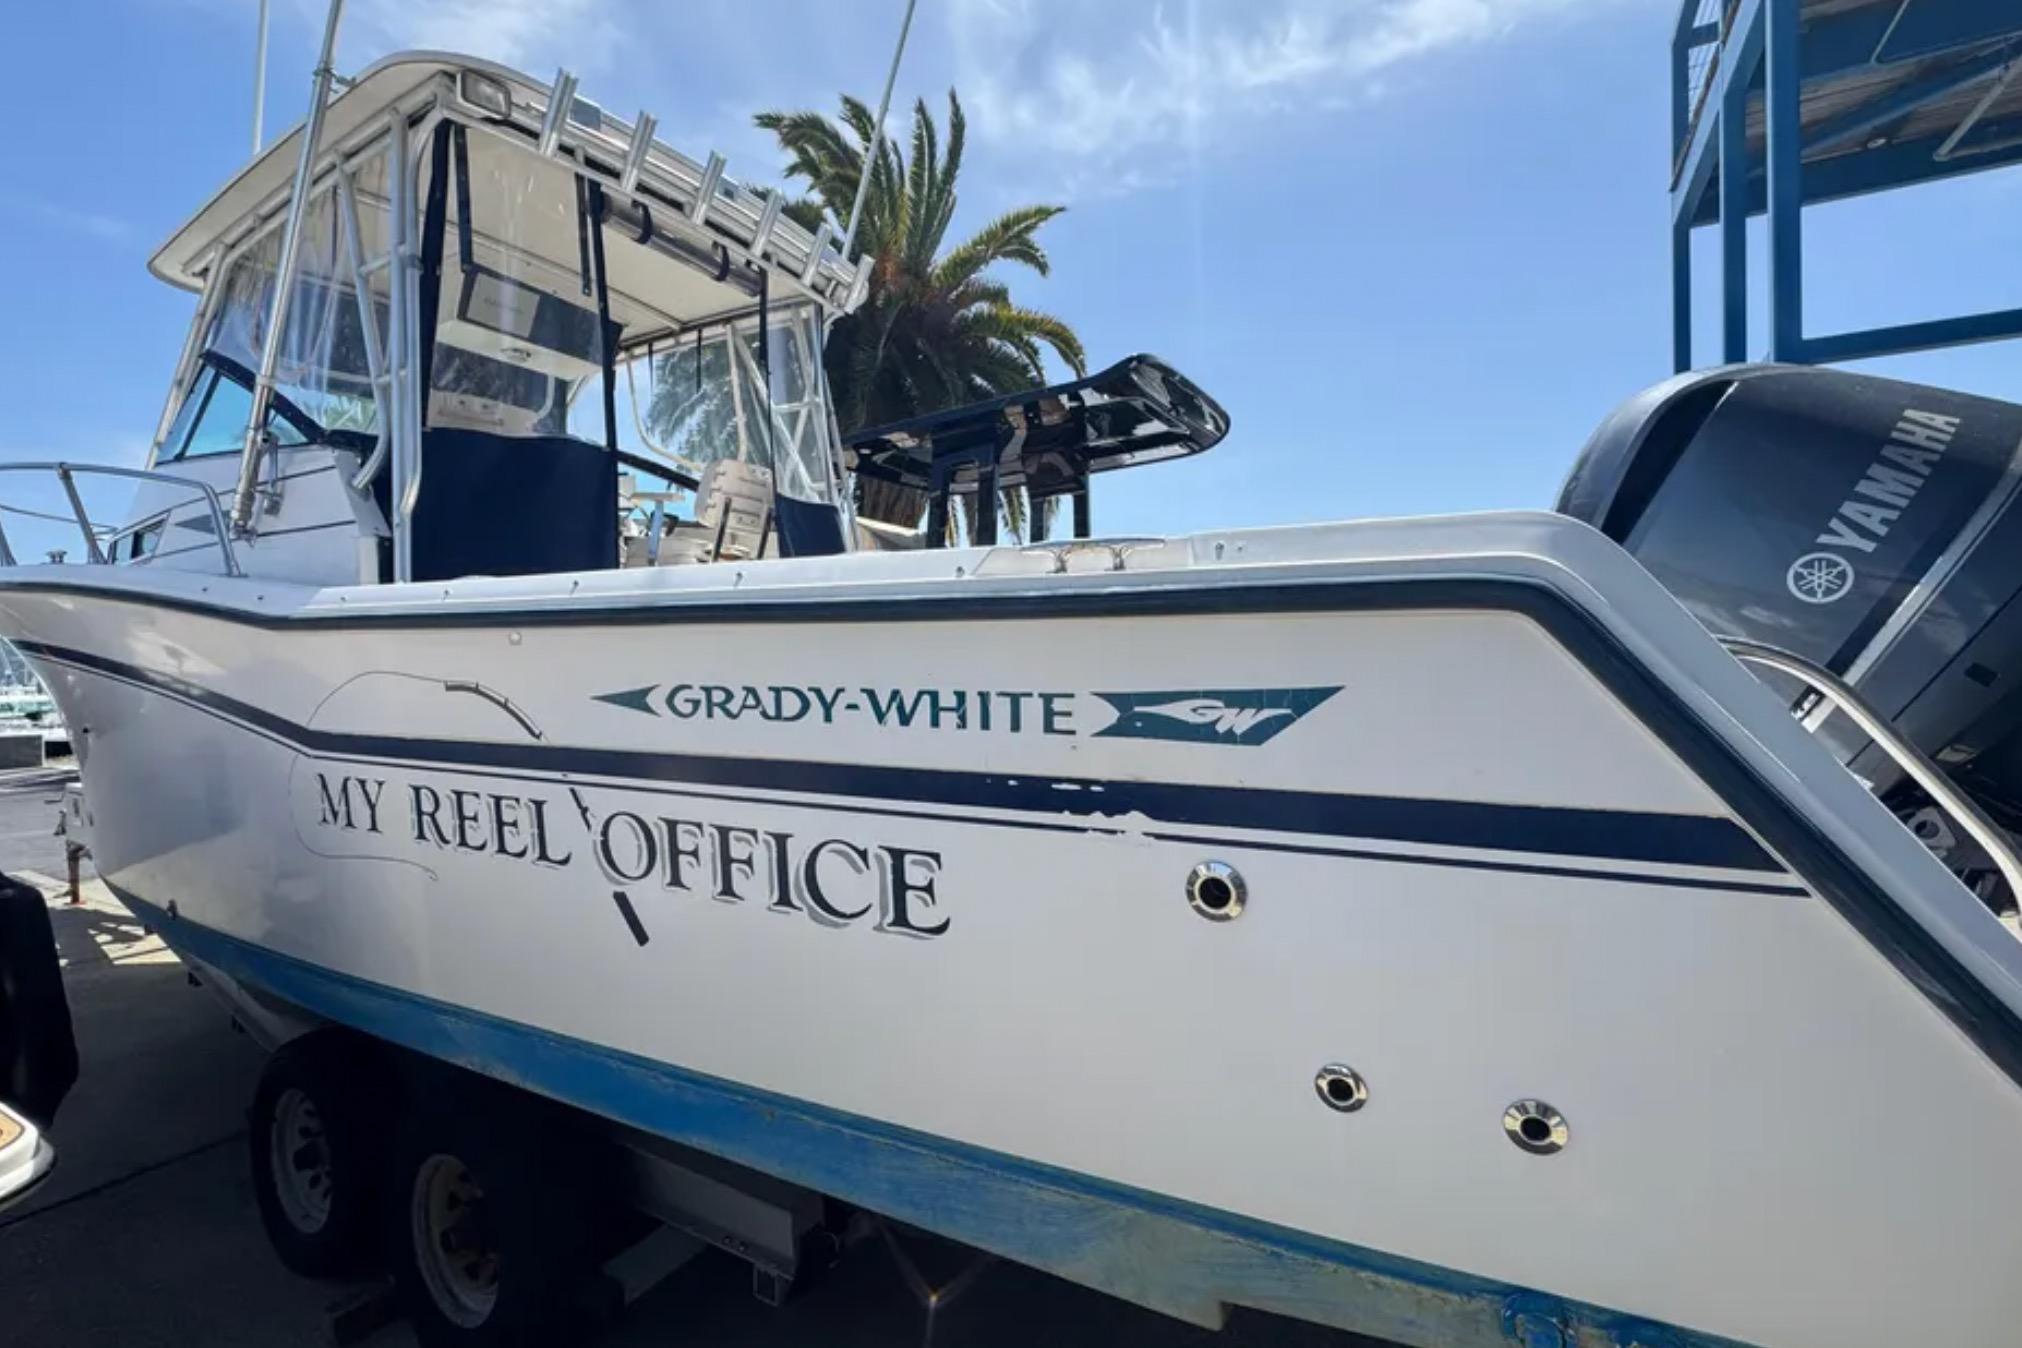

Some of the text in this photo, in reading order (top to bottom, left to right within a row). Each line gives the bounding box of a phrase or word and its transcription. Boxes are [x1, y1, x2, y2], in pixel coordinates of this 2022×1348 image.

[1815, 408, 1961, 553] YAMAHA
[665, 683, 1077, 735] GRADY-WHITE
[317, 773, 951, 938] MY REEL OFFICE
